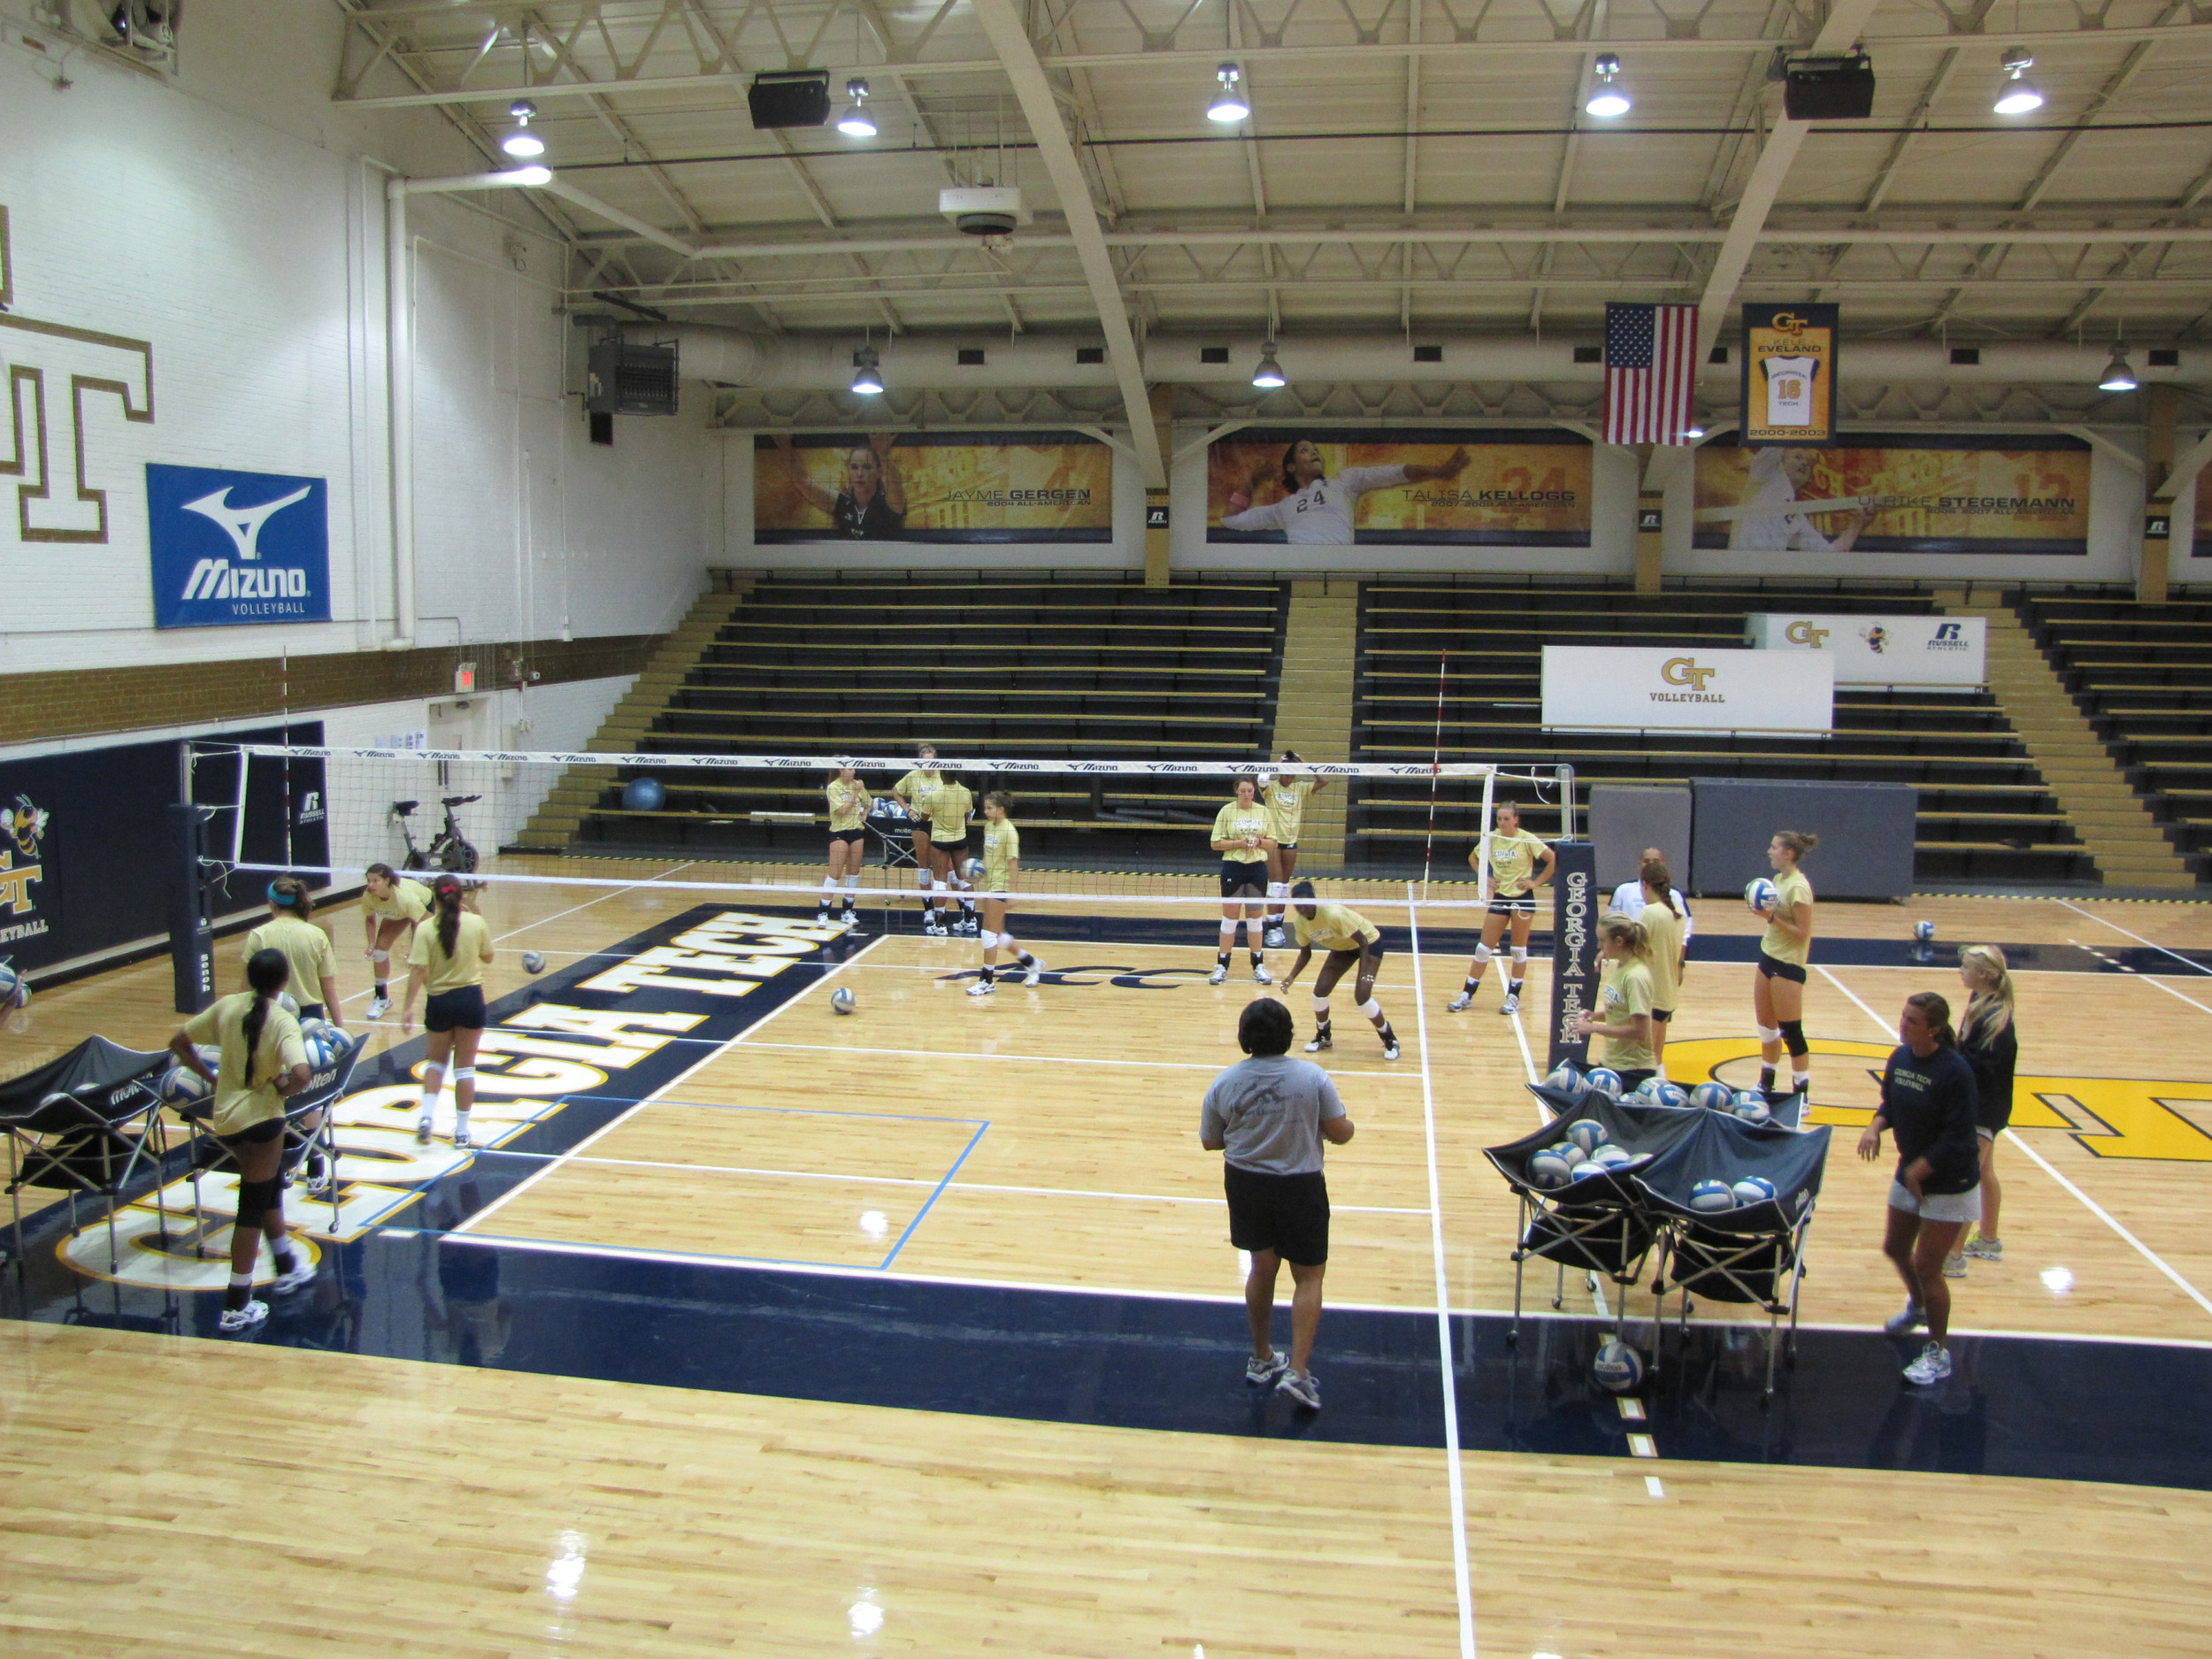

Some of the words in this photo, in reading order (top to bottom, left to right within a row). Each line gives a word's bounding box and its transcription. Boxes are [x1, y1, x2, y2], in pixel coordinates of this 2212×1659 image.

[1771, 311, 1809, 336] GT
[947, 489, 1003, 500] JAYME
[1010, 489, 1091, 500] GERGEN
[1296, 489, 1326, 513] 24
[1402, 489, 1473, 501] TALISA
[1479, 490, 1575, 501] KELLOGG
[1857, 495, 1932, 507] ULRIKE
[1938, 496, 2076, 509] STEGEMANN
[181, 558, 307, 600] MIZUNO
[233, 603, 306, 615] VOLLEYBALL
[1786, 621, 1830, 649] GT
[1661, 657, 1716, 691] GT
[1649, 693, 1725, 703] VOLLEYBALL
[0, 919, 50, 944] EYBALL
[1563, 872, 1588, 977] GEORGIA
[575, 911, 855, 997] TECH
[1894, 1068, 1915, 1079] GEORGIA
[1916, 1073, 1932, 1085] TECH
[1894, 1076, 1924, 1091] VOLLEYBALL
